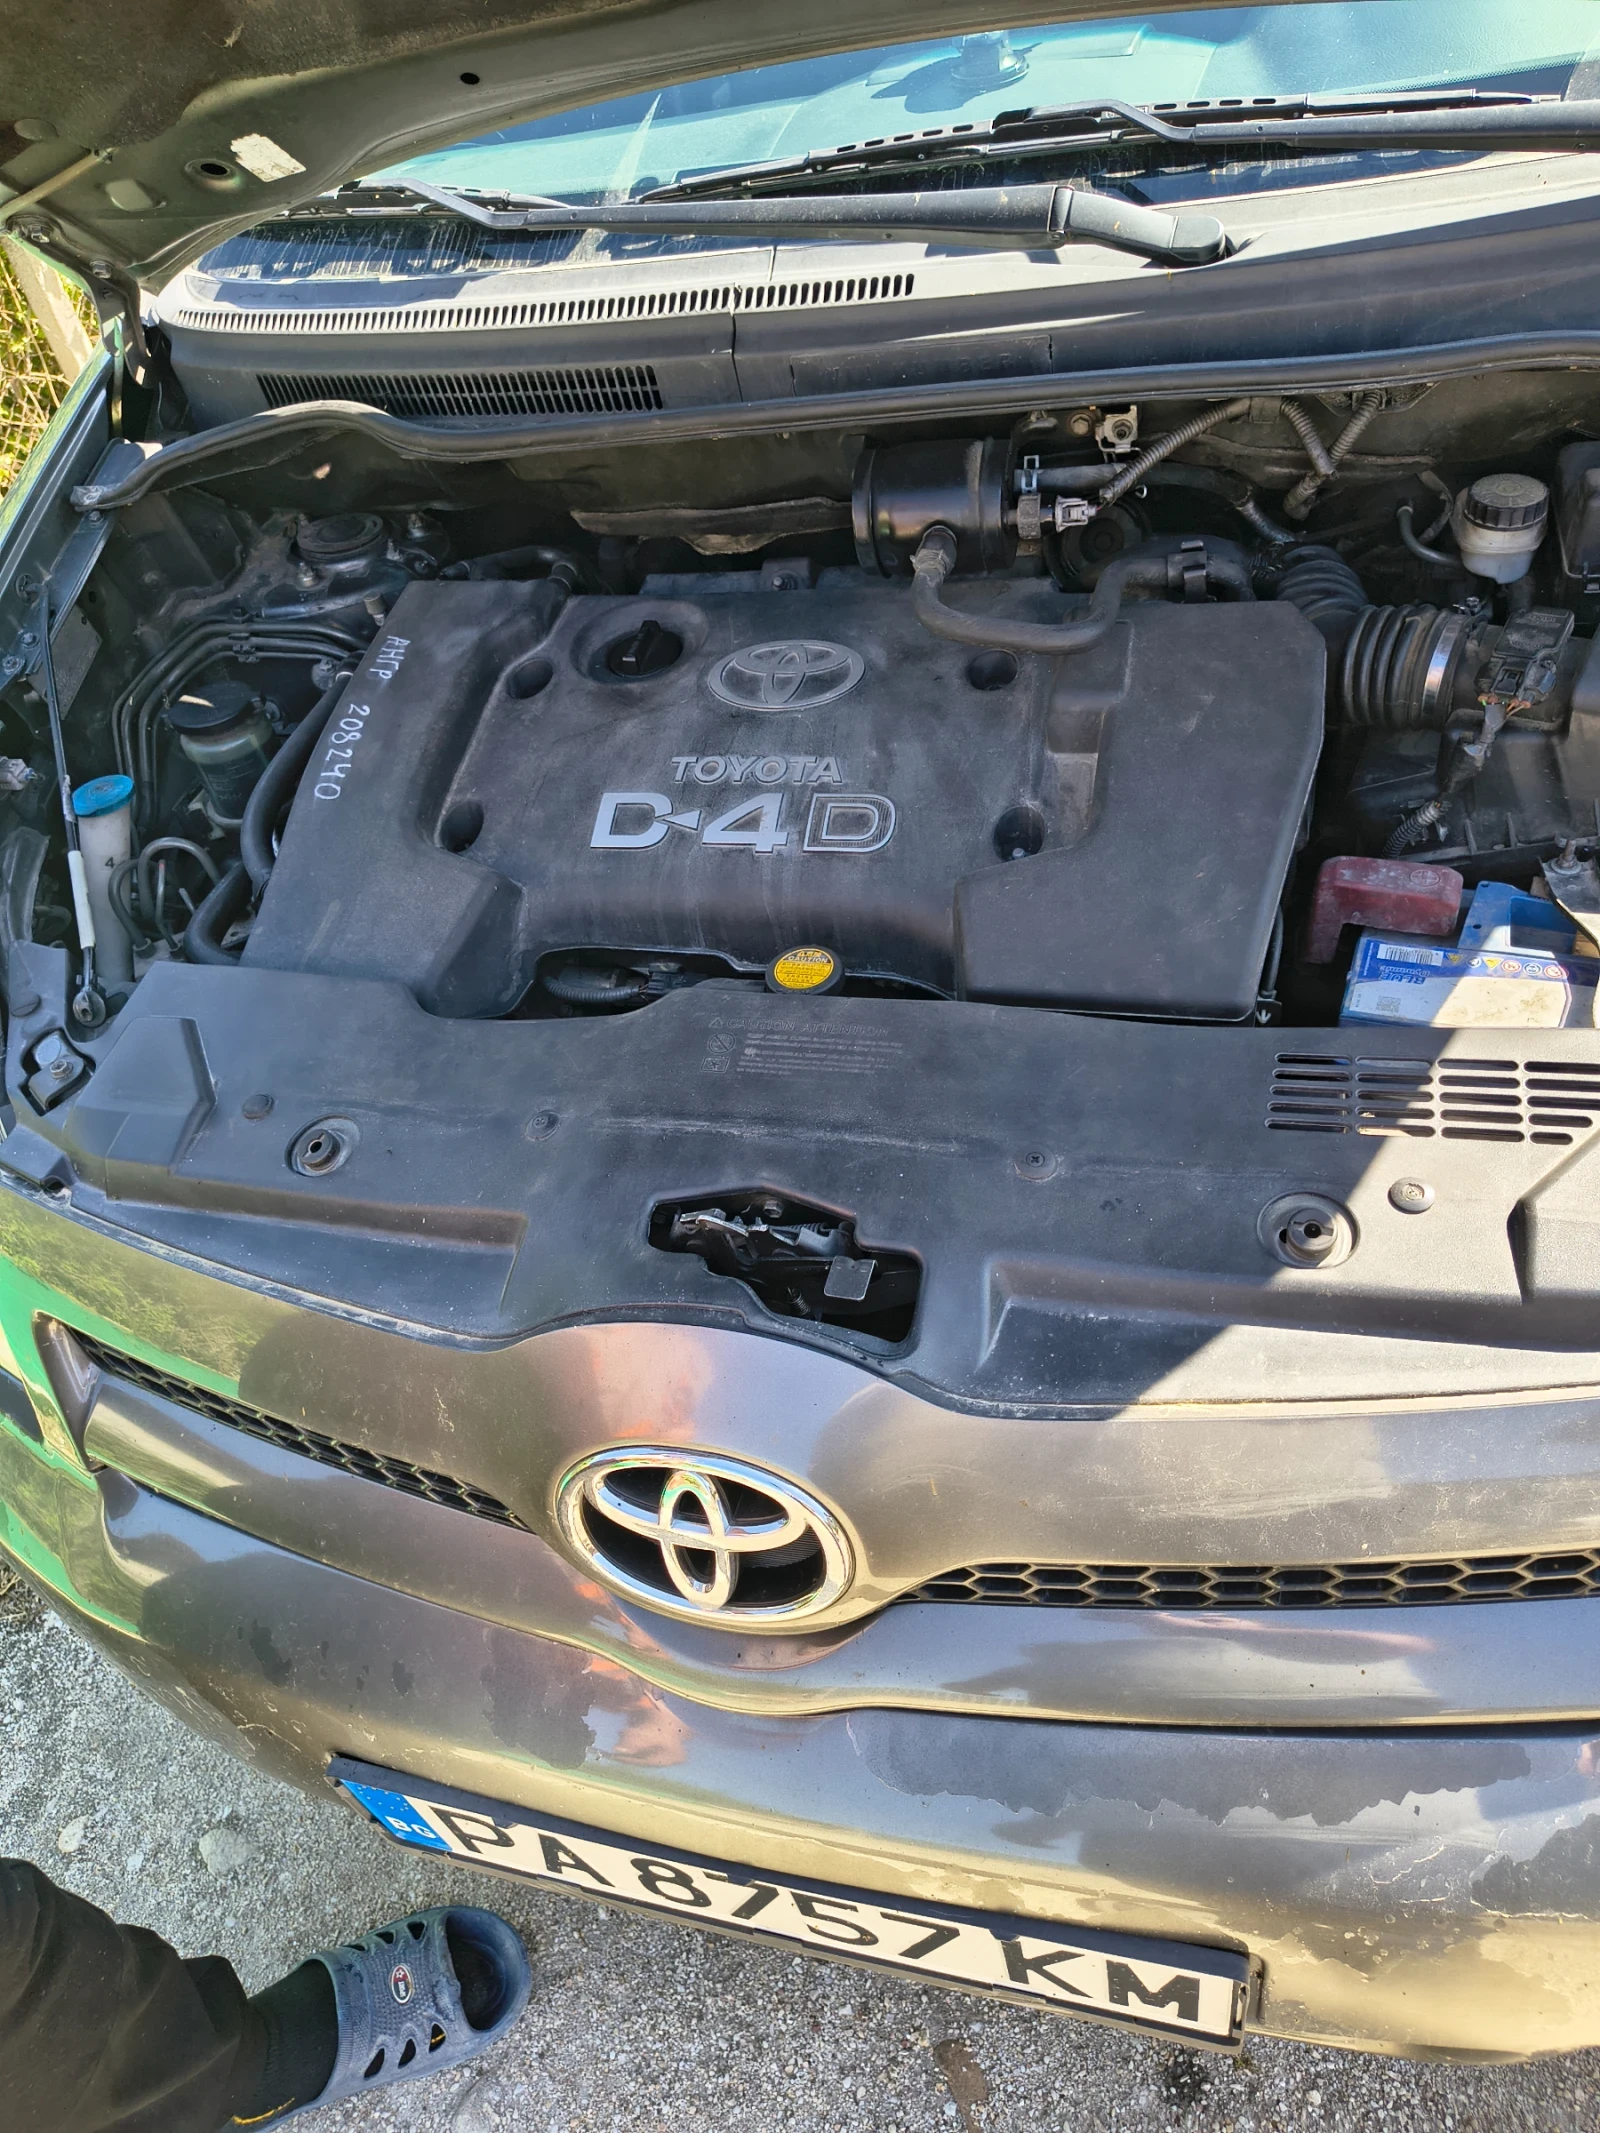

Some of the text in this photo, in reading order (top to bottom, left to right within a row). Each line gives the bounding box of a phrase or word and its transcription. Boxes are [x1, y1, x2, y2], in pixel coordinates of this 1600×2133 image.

[314, 703, 370, 800] 208240
[671, 756, 844, 785] TOYOTA
[590, 792, 897, 855] D-4D
[105, 857, 115, 868] 4
[788, 954, 828, 963] CAUTION
[1381, 972, 1426, 984] BLUE
[727, 1019, 890, 1037] CAUTION ATTENTION
[385, 1815, 437, 1840] BG
